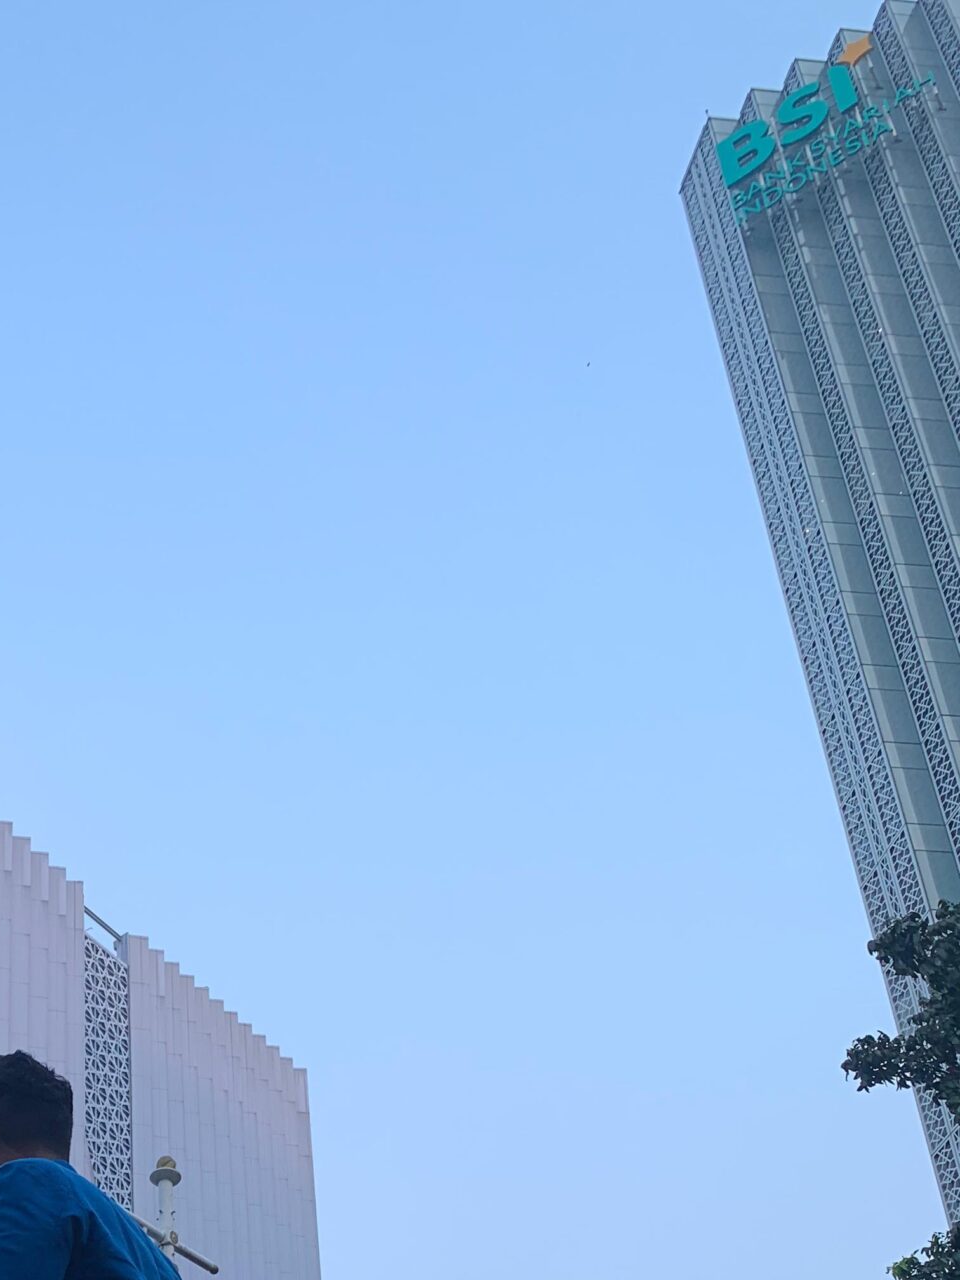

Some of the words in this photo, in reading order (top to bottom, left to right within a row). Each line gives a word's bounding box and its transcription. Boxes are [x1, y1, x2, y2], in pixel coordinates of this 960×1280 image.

[716, 64, 859, 188] BSI
[732, 151, 805, 210] BANK
[811, 70, 936, 157] SYARIAH
[736, 121, 894, 226] INDONESIA
